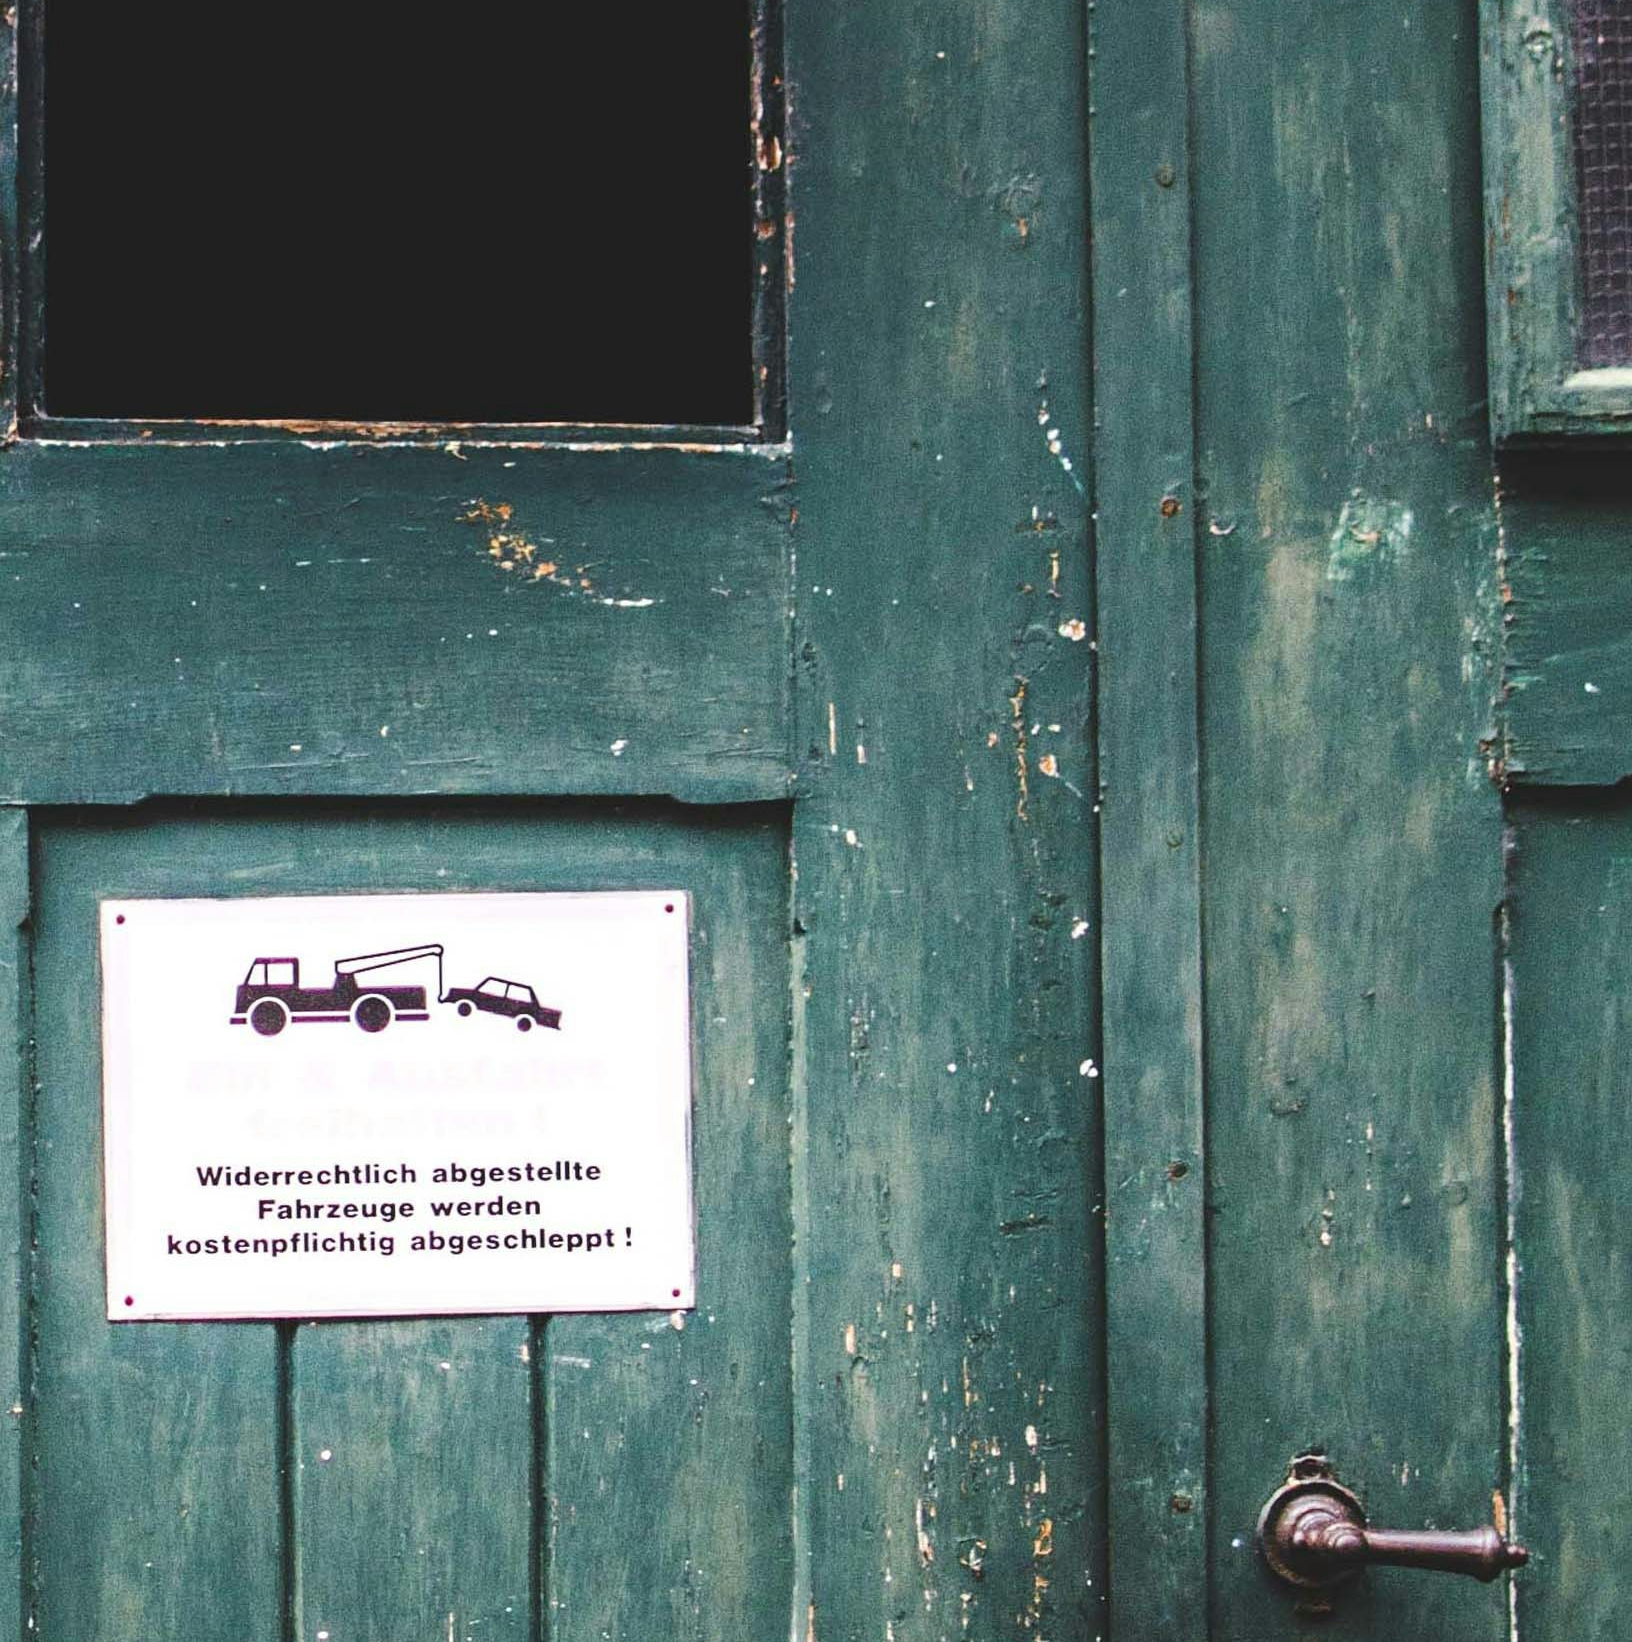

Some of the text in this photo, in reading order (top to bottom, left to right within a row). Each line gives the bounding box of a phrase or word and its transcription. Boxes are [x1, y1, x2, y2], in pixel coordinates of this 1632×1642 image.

[196, 1160, 601, 1187] Widerrechtlich abgestellte
[258, 1195, 541, 1223] Fahrzeuge werden
[167, 1231, 394, 1258] kostenpflichtig
